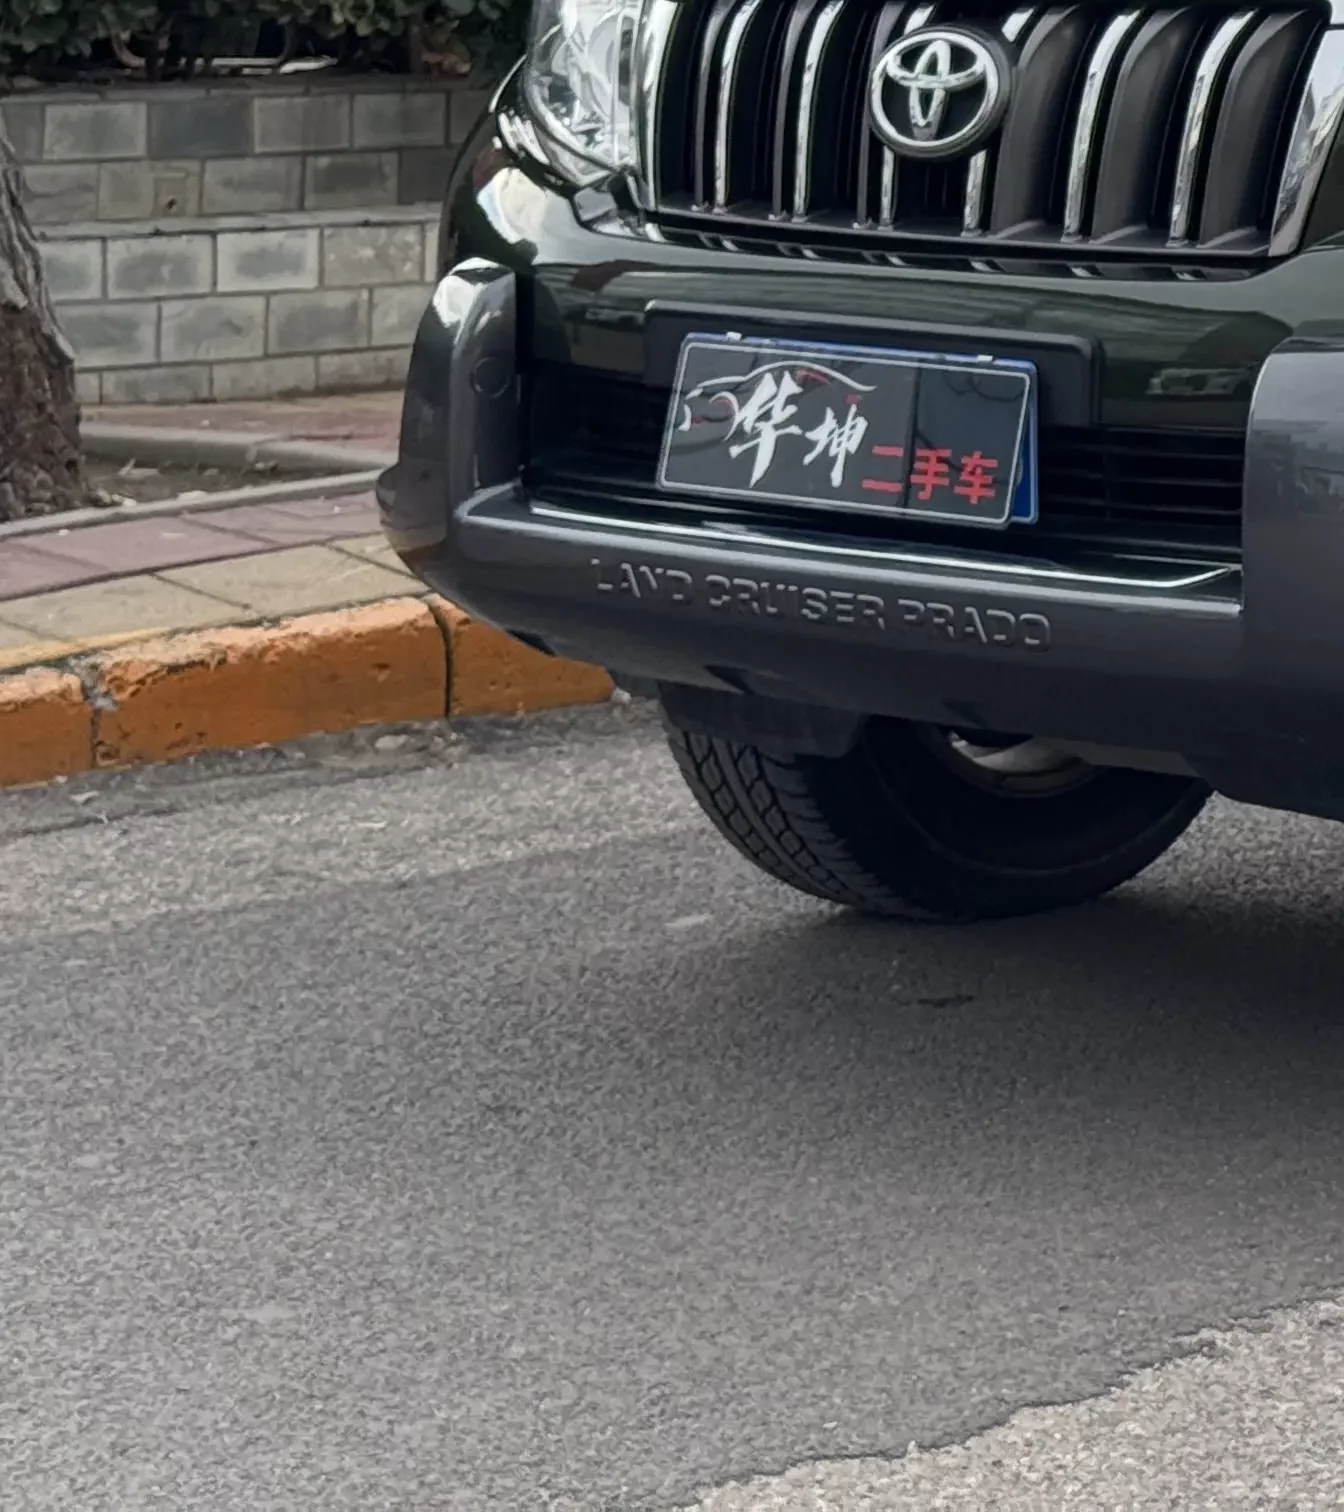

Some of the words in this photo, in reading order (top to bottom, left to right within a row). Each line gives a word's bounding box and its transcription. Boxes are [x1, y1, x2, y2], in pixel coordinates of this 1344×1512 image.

[728, 370, 869, 488] 华坤
[861, 444, 999, 505] 二手车
[590, 557, 693, 602] LAND
[704, 574, 885, 631] CRUISER
[898, 598, 1051, 652] PRADO
